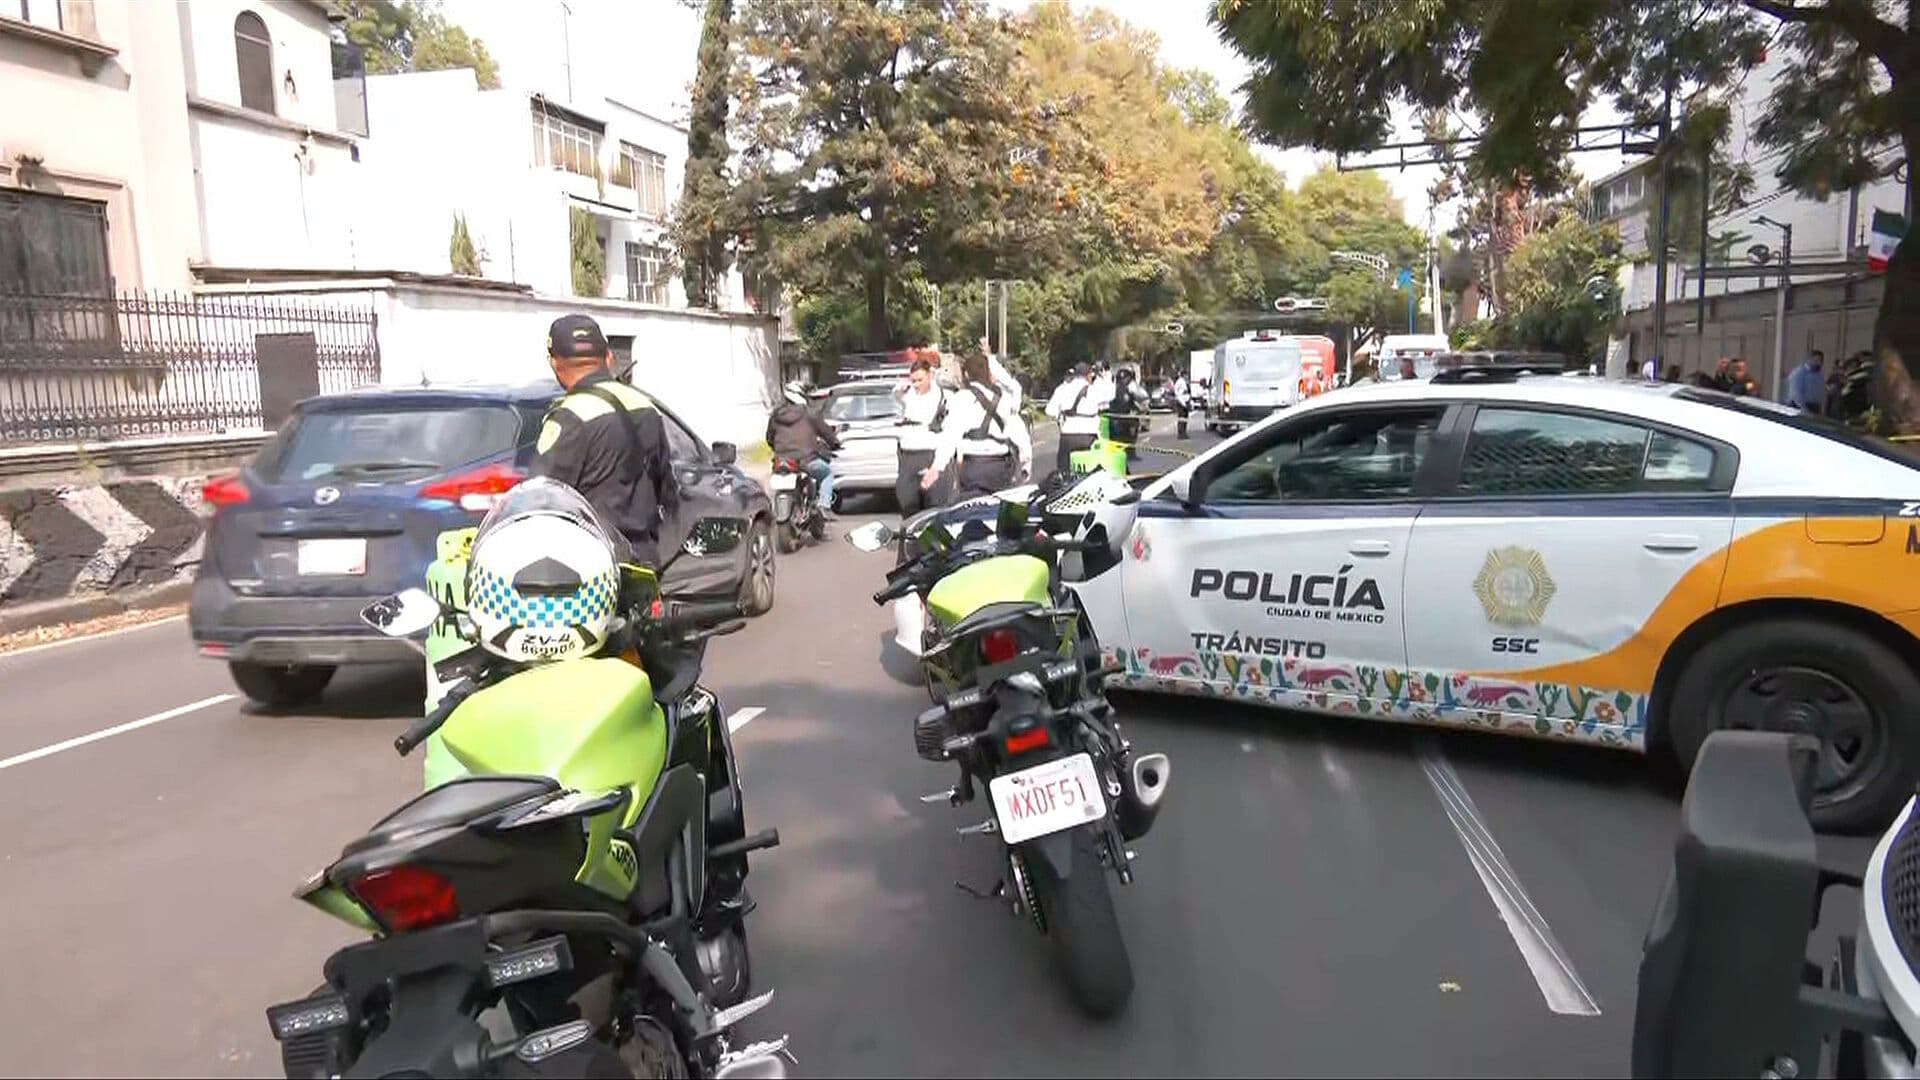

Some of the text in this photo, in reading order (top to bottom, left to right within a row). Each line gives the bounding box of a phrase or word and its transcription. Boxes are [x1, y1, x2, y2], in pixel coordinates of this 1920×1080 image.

[1190, 564, 1385, 611] POLICÍA
[1266, 606, 1385, 624] CIUDAD DE MEXICO
[1190, 629, 1326, 660] TRÁNSITO
[1492, 636, 1540, 654] SSC
[1006, 776, 1087, 822] MXDF51
